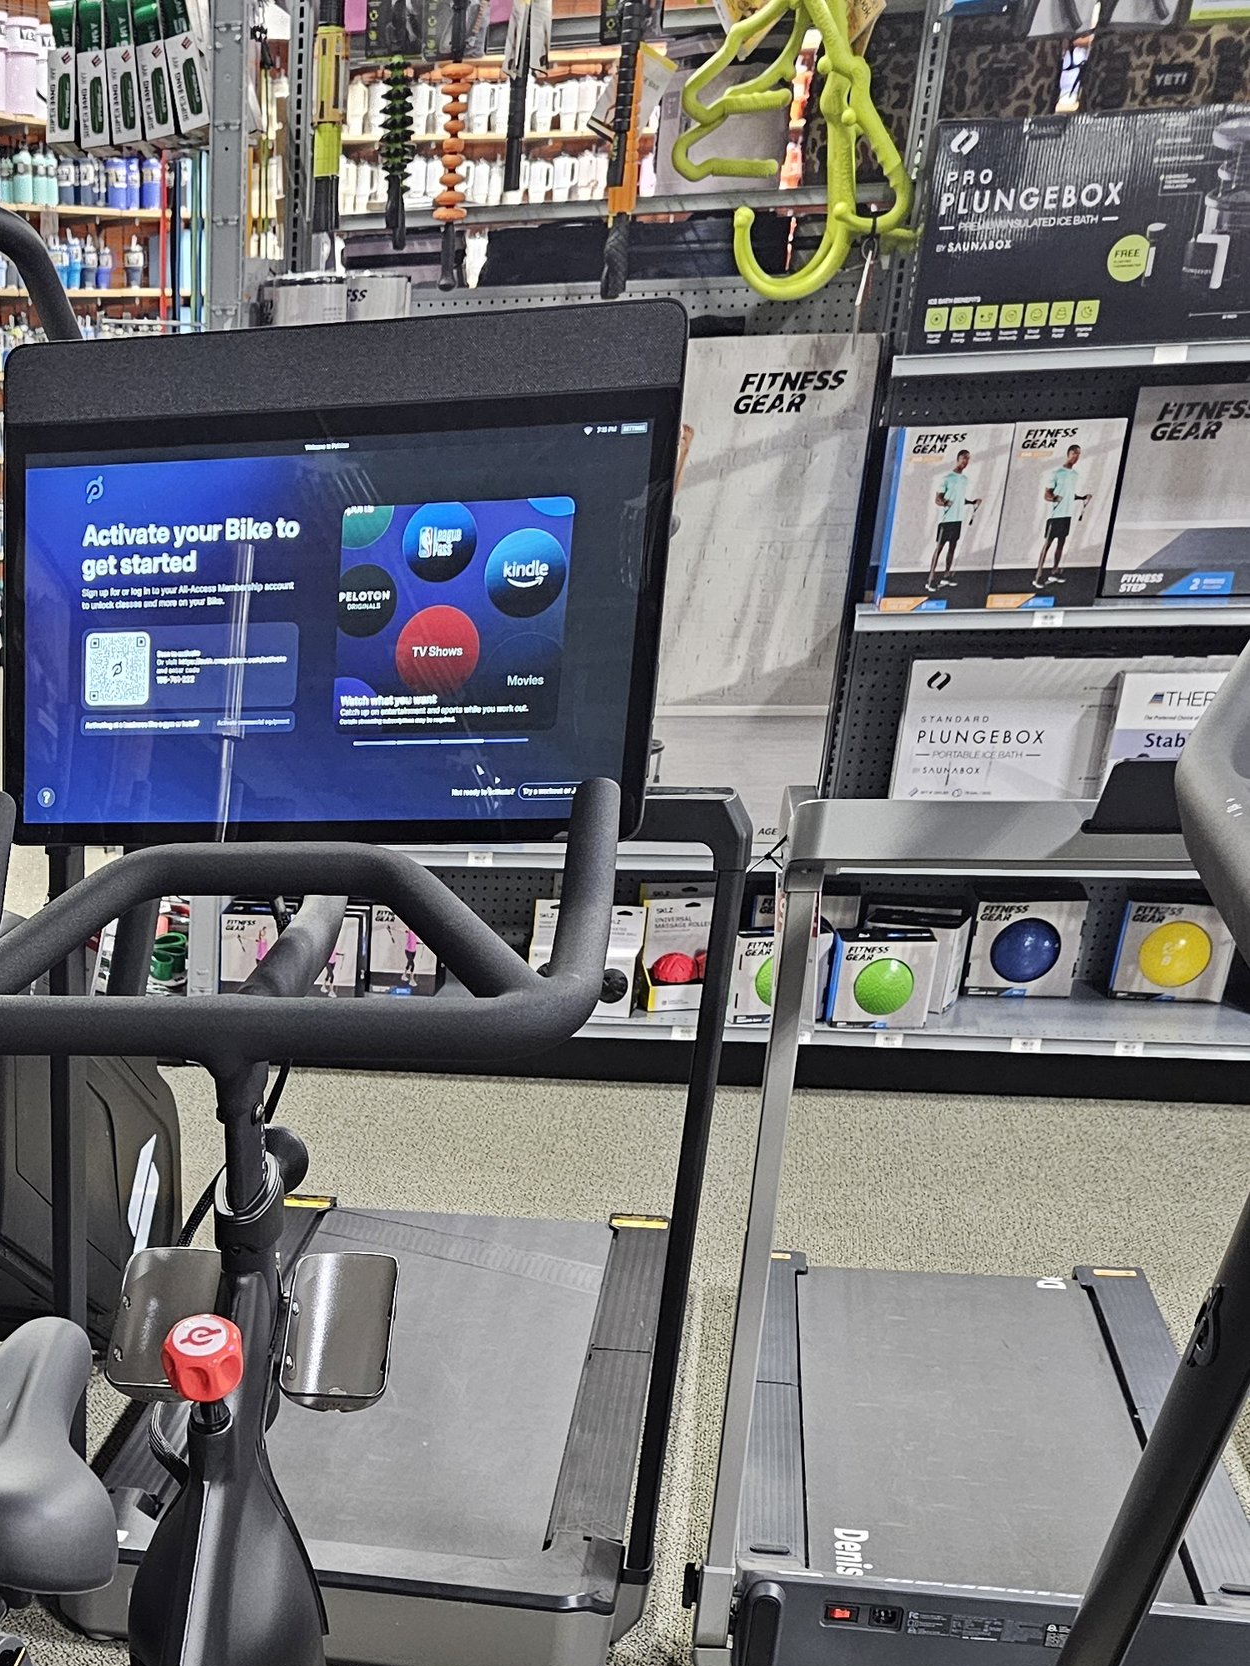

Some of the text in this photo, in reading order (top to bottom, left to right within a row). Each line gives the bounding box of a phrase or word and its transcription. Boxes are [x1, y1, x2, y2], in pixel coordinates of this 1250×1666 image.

[1155, 72, 1186, 86] YETI
[946, 168, 993, 187] PRO
[939, 181, 1124, 216] PLUNGEBOX
[1002, 216, 1056, 231] INSULATED
[1057, 216, 1072, 226] ICE
[1073, 214, 1099, 225] BATH
[947, 239, 1012, 253] SAUNABOX
[1114, 248, 1141, 259] FREE
[739, 369, 848, 393] FITNESS
[733, 393, 807, 414] GEAR
[1025, 427, 1079, 439] FITNESS
[1150, 420, 1223, 441] GEAR
[915, 432, 968, 444] FITNESS
[1021, 438, 1058, 450] GEAR
[912, 443, 949, 455] GEAR
[82, 517, 300, 548] Activate your Bike to
[433, 527, 462, 543] League
[432, 542, 453, 557] Pass
[82, 550, 197, 581] get started
[503, 560, 549, 578] kindle
[1121, 573, 1164, 584] FITNESS
[1188, 578, 1199, 590] 2
[82, 588, 98, 598] Sign
[99, 589, 109, 598] up
[110, 588, 121, 597] for
[131, 587, 142, 598] log
[161, 587, 177, 597] your
[178, 584, 217, 595] All-Access
[218, 582, 263, 593] Membership
[264, 581, 295, 591] account
[1119, 583, 1146, 593] STEP
[339, 590, 390, 602] PELOTON
[91, 600, 114, 610] unlock
[115, 600, 142, 609] classes
[143, 599, 157, 608] and
[158, 599, 178, 608] more
[189, 598, 206, 608] your
[207, 597, 225, 606] Bike.
[347, 602, 381, 611] ORIGINALS
[412, 645, 463, 657] TV Shows
[507, 675, 544, 687] Movies
[340, 694, 438, 707] Watch what you want
[340, 708, 360, 717] Catch
[381, 707, 426, 716] entertainment
[427, 706, 440, 715] and
[441, 706, 463, 716] sports
[482, 705, 496, 715] you
[921, 715, 990, 723] STANDARD
[917, 730, 1045, 744] PLUNGEBOX
[1144, 733, 1186, 748] Stab
[932, 750, 1023, 759] PORTABLE ICE BATH
[922, 766, 981, 775] SAUNABOX
[983, 904, 1030, 914] FITNESS
[1135, 905, 1185, 916] FITNESS
[226, 919, 256, 927] FITNESS
[980, 913, 1012, 922] GEAR
[1131, 914, 1166, 923] GEAR
[745, 948, 772, 957] GEAR
[847, 946, 890, 954] FITNESS
[845, 953, 875, 961] GEAR
[833, 1527, 873, 1577] Denis
